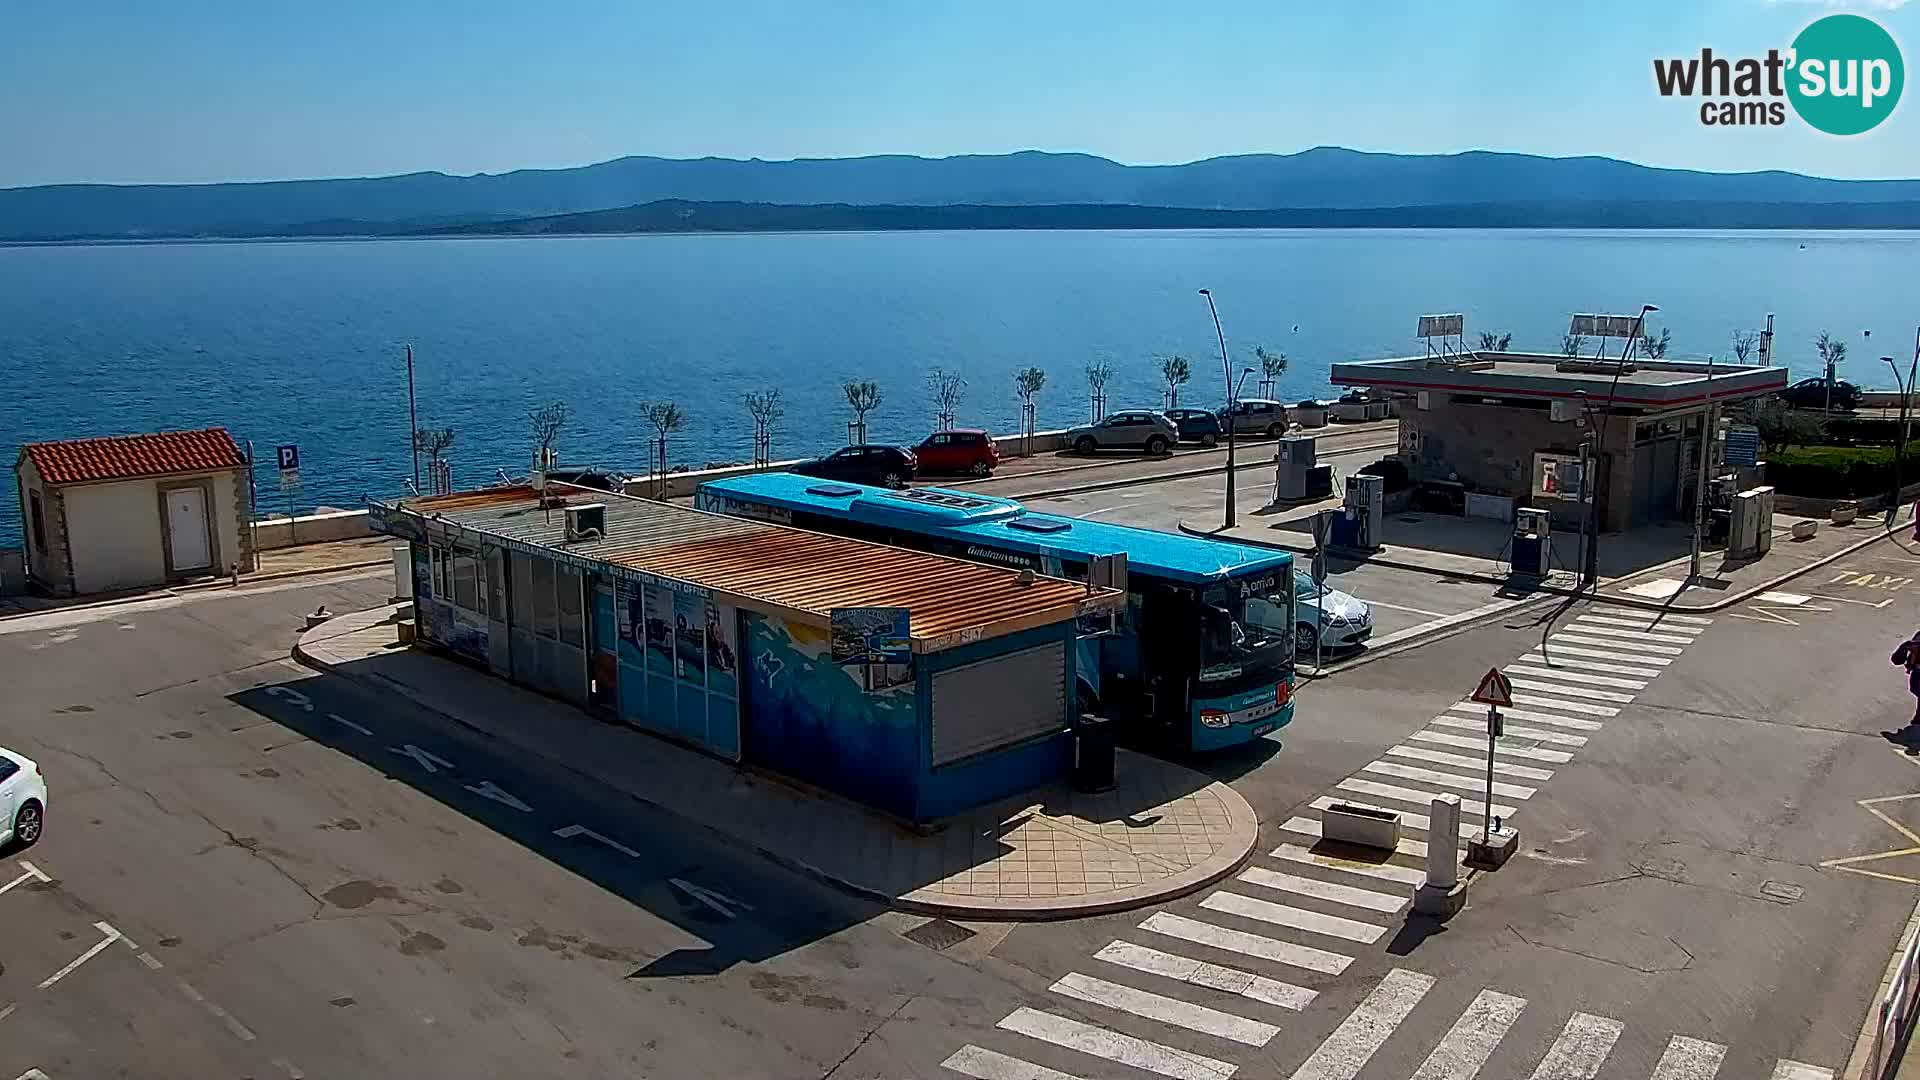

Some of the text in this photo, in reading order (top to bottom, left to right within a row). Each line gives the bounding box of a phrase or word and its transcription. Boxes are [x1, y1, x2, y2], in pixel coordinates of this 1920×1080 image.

[282, 449, 293, 466] P
[625, 570, 655, 584] STATION
[658, 578, 681, 591] TICKET
[684, 585, 709, 598] OFFICE
[1250, 577, 1275, 592] arriva
